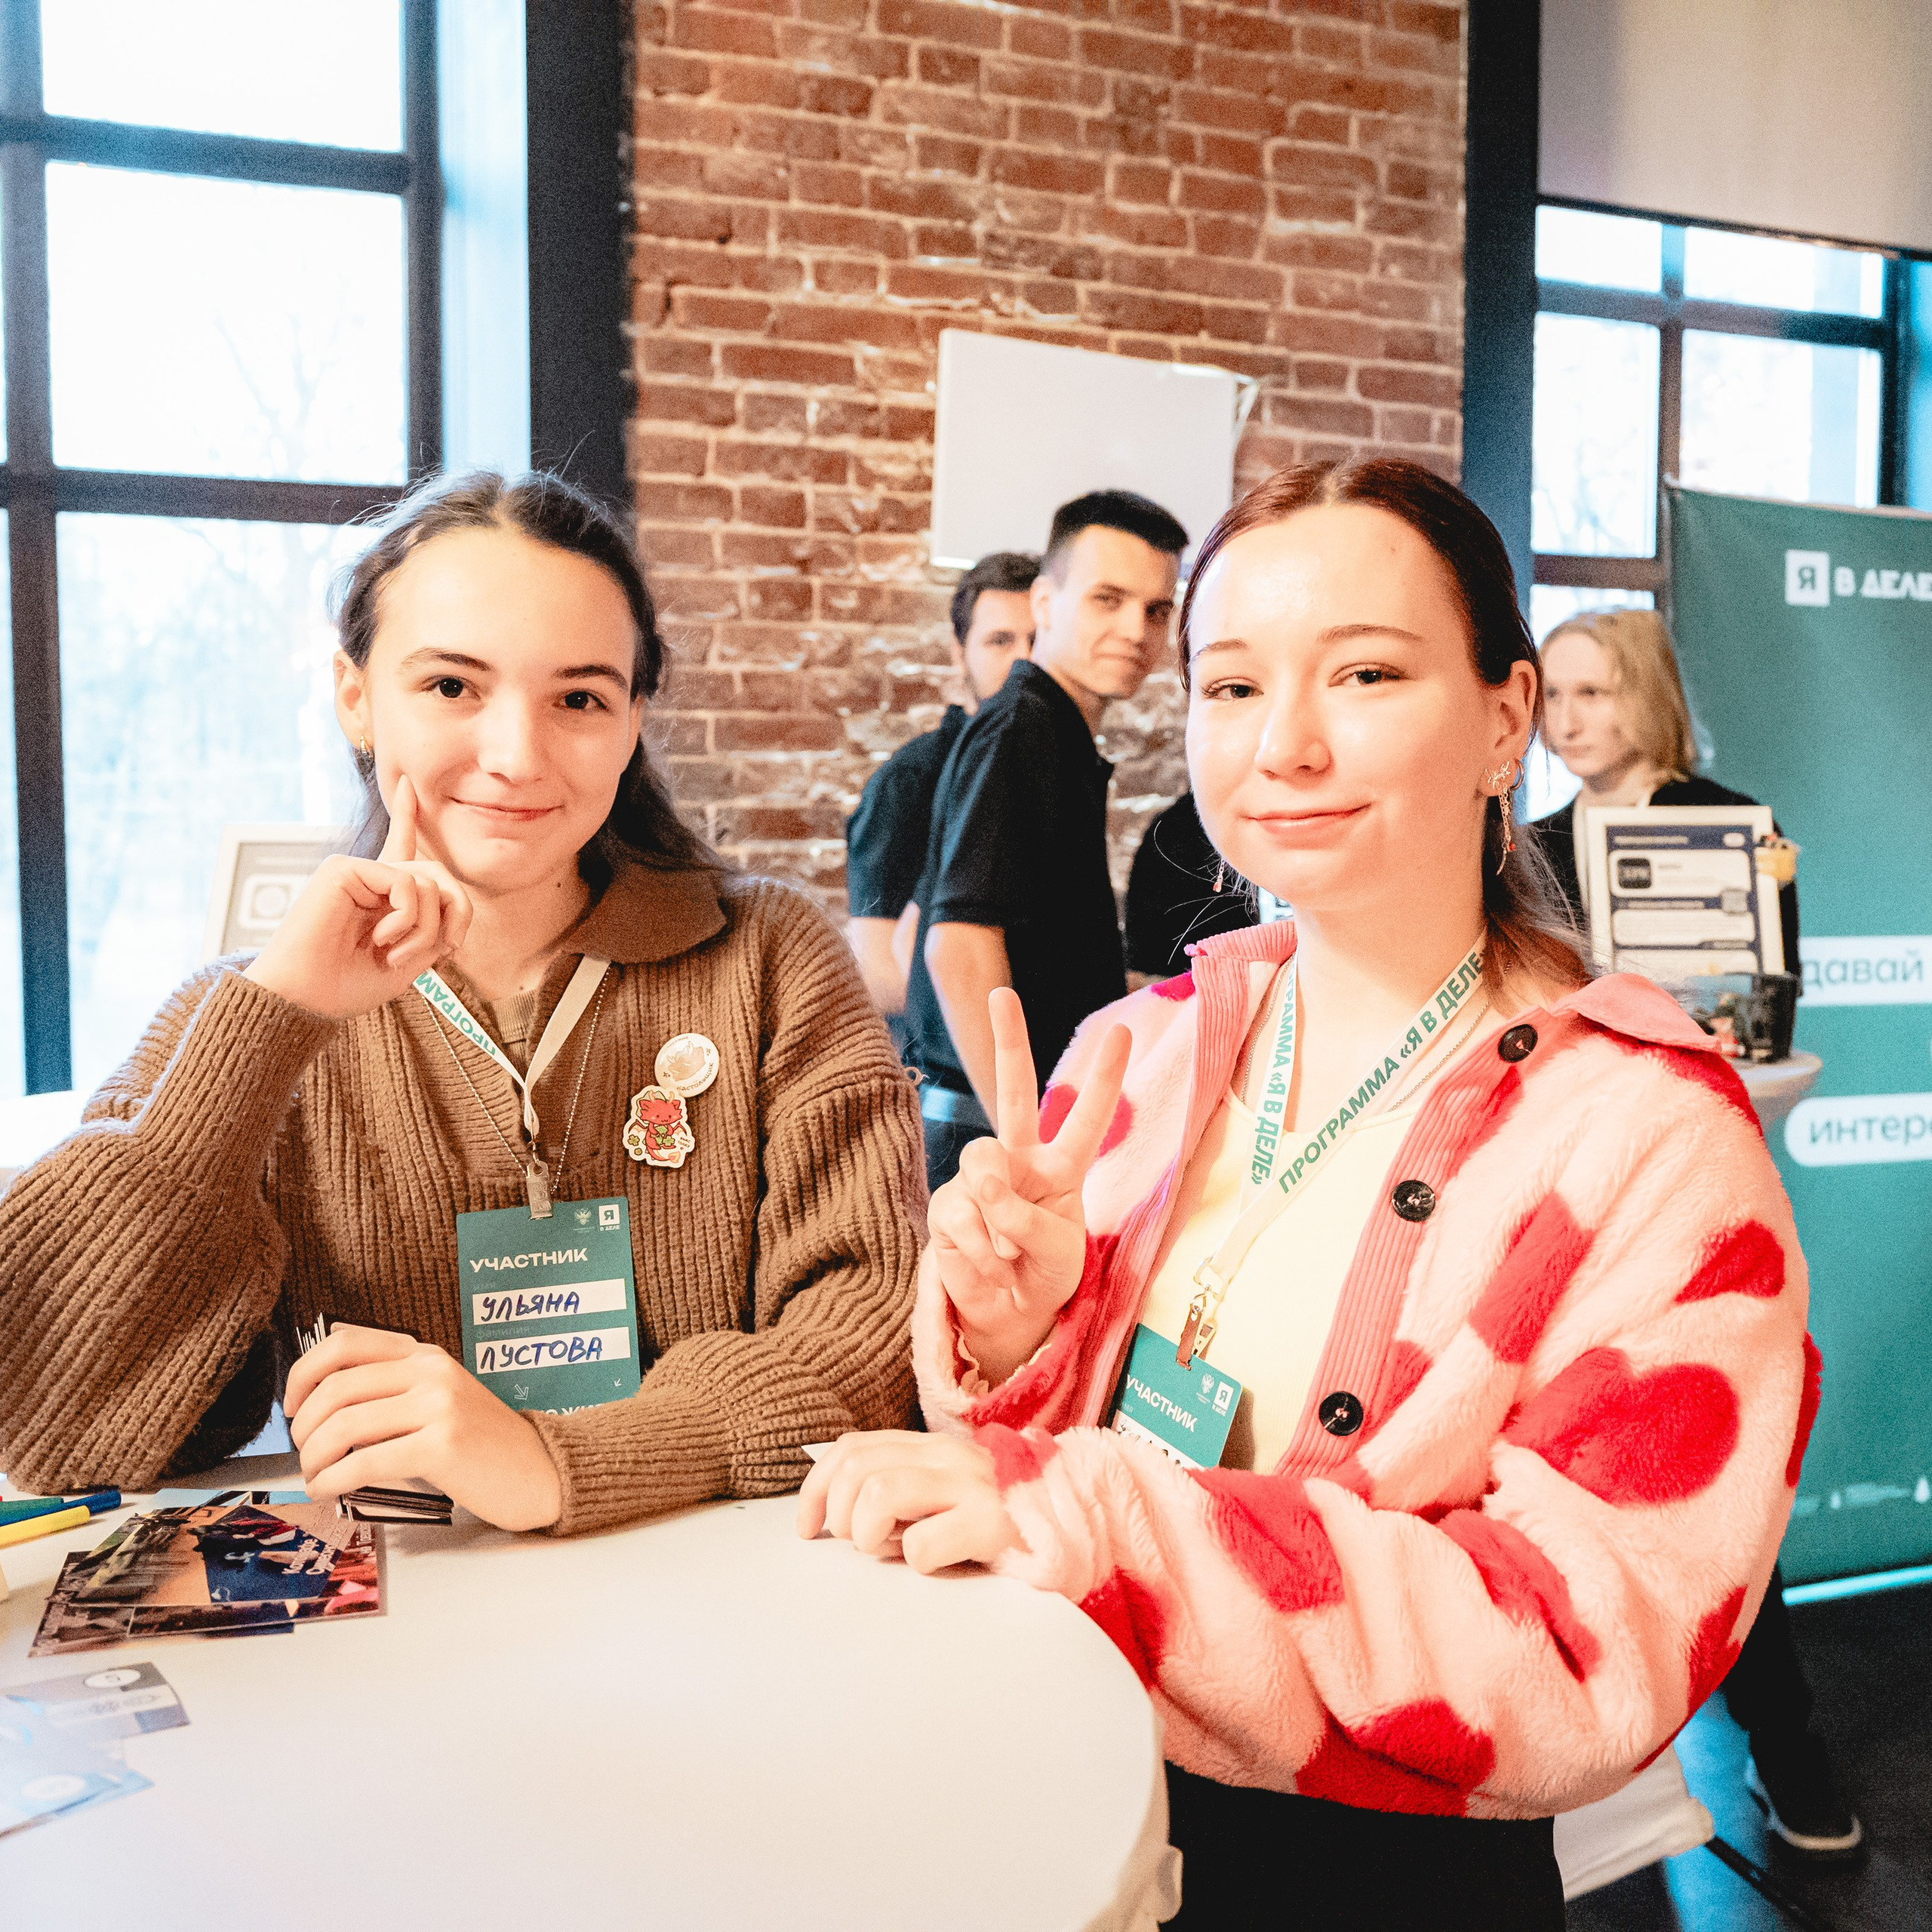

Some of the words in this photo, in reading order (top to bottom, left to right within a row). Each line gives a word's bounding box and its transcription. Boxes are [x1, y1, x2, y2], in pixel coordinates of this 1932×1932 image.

[1835, 567, 1856, 596] В
[1860, 569, 1932, 601] ДЕЛЕ
[1802, 949, 1923, 990] давай
[1263, 1100, 1283, 1115] В
[1278, 1057, 1401, 1195] ПРОГРАММА
[1420, 1010, 1438, 1034] В
[1809, 1114, 1932, 1145] интер
[1251, 1115, 1279, 1186] ДЕЛЕ»
[469, 1247, 589, 1273] УЧАСТНИК
[481, 1291, 580, 1322] УЛЬЯНА
[1126, 1374, 1198, 1433] УЧАСТНИК
